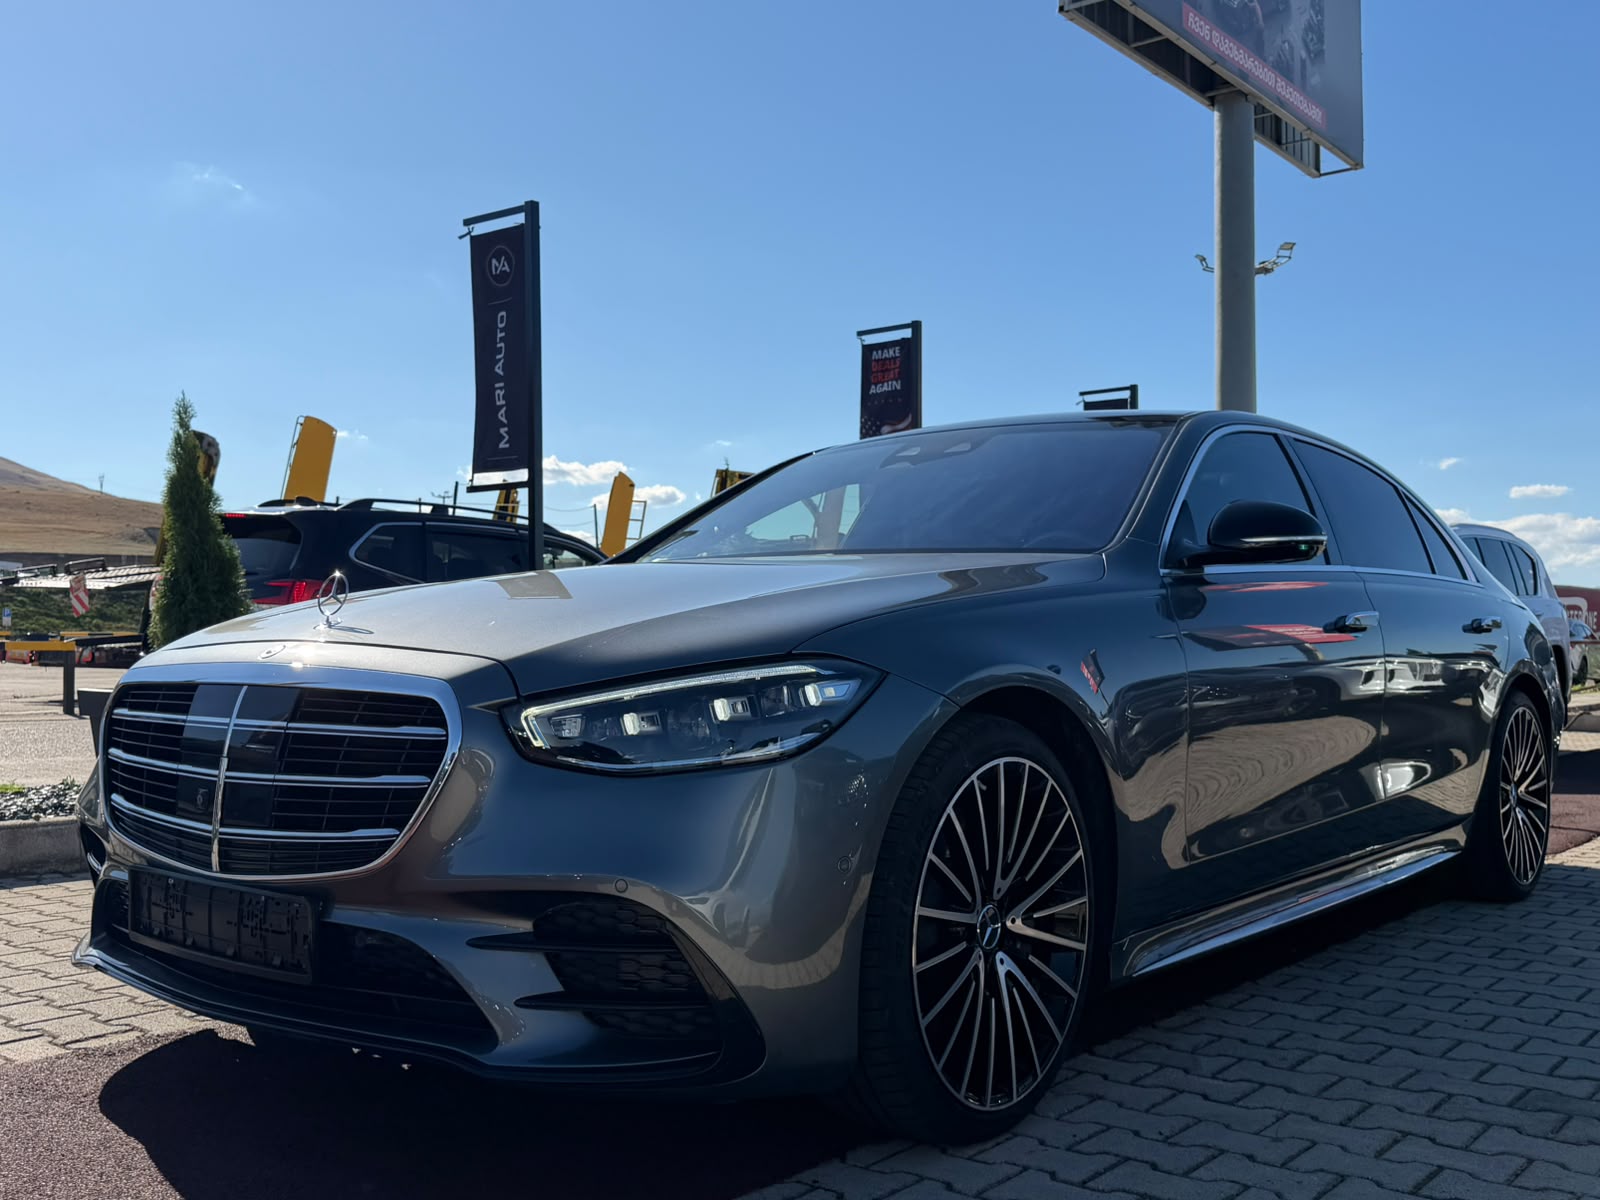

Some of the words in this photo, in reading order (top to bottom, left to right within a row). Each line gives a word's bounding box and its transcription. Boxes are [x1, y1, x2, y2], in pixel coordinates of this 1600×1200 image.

[1188, 12, 1210, 41] ჩვენ
[495, 310, 507, 376] AUTO
[872, 346, 901, 360] MAKE
[869, 379, 901, 394] AGAIN
[872, 368, 900, 384] GREAT
[494, 382, 510, 449] MARI
